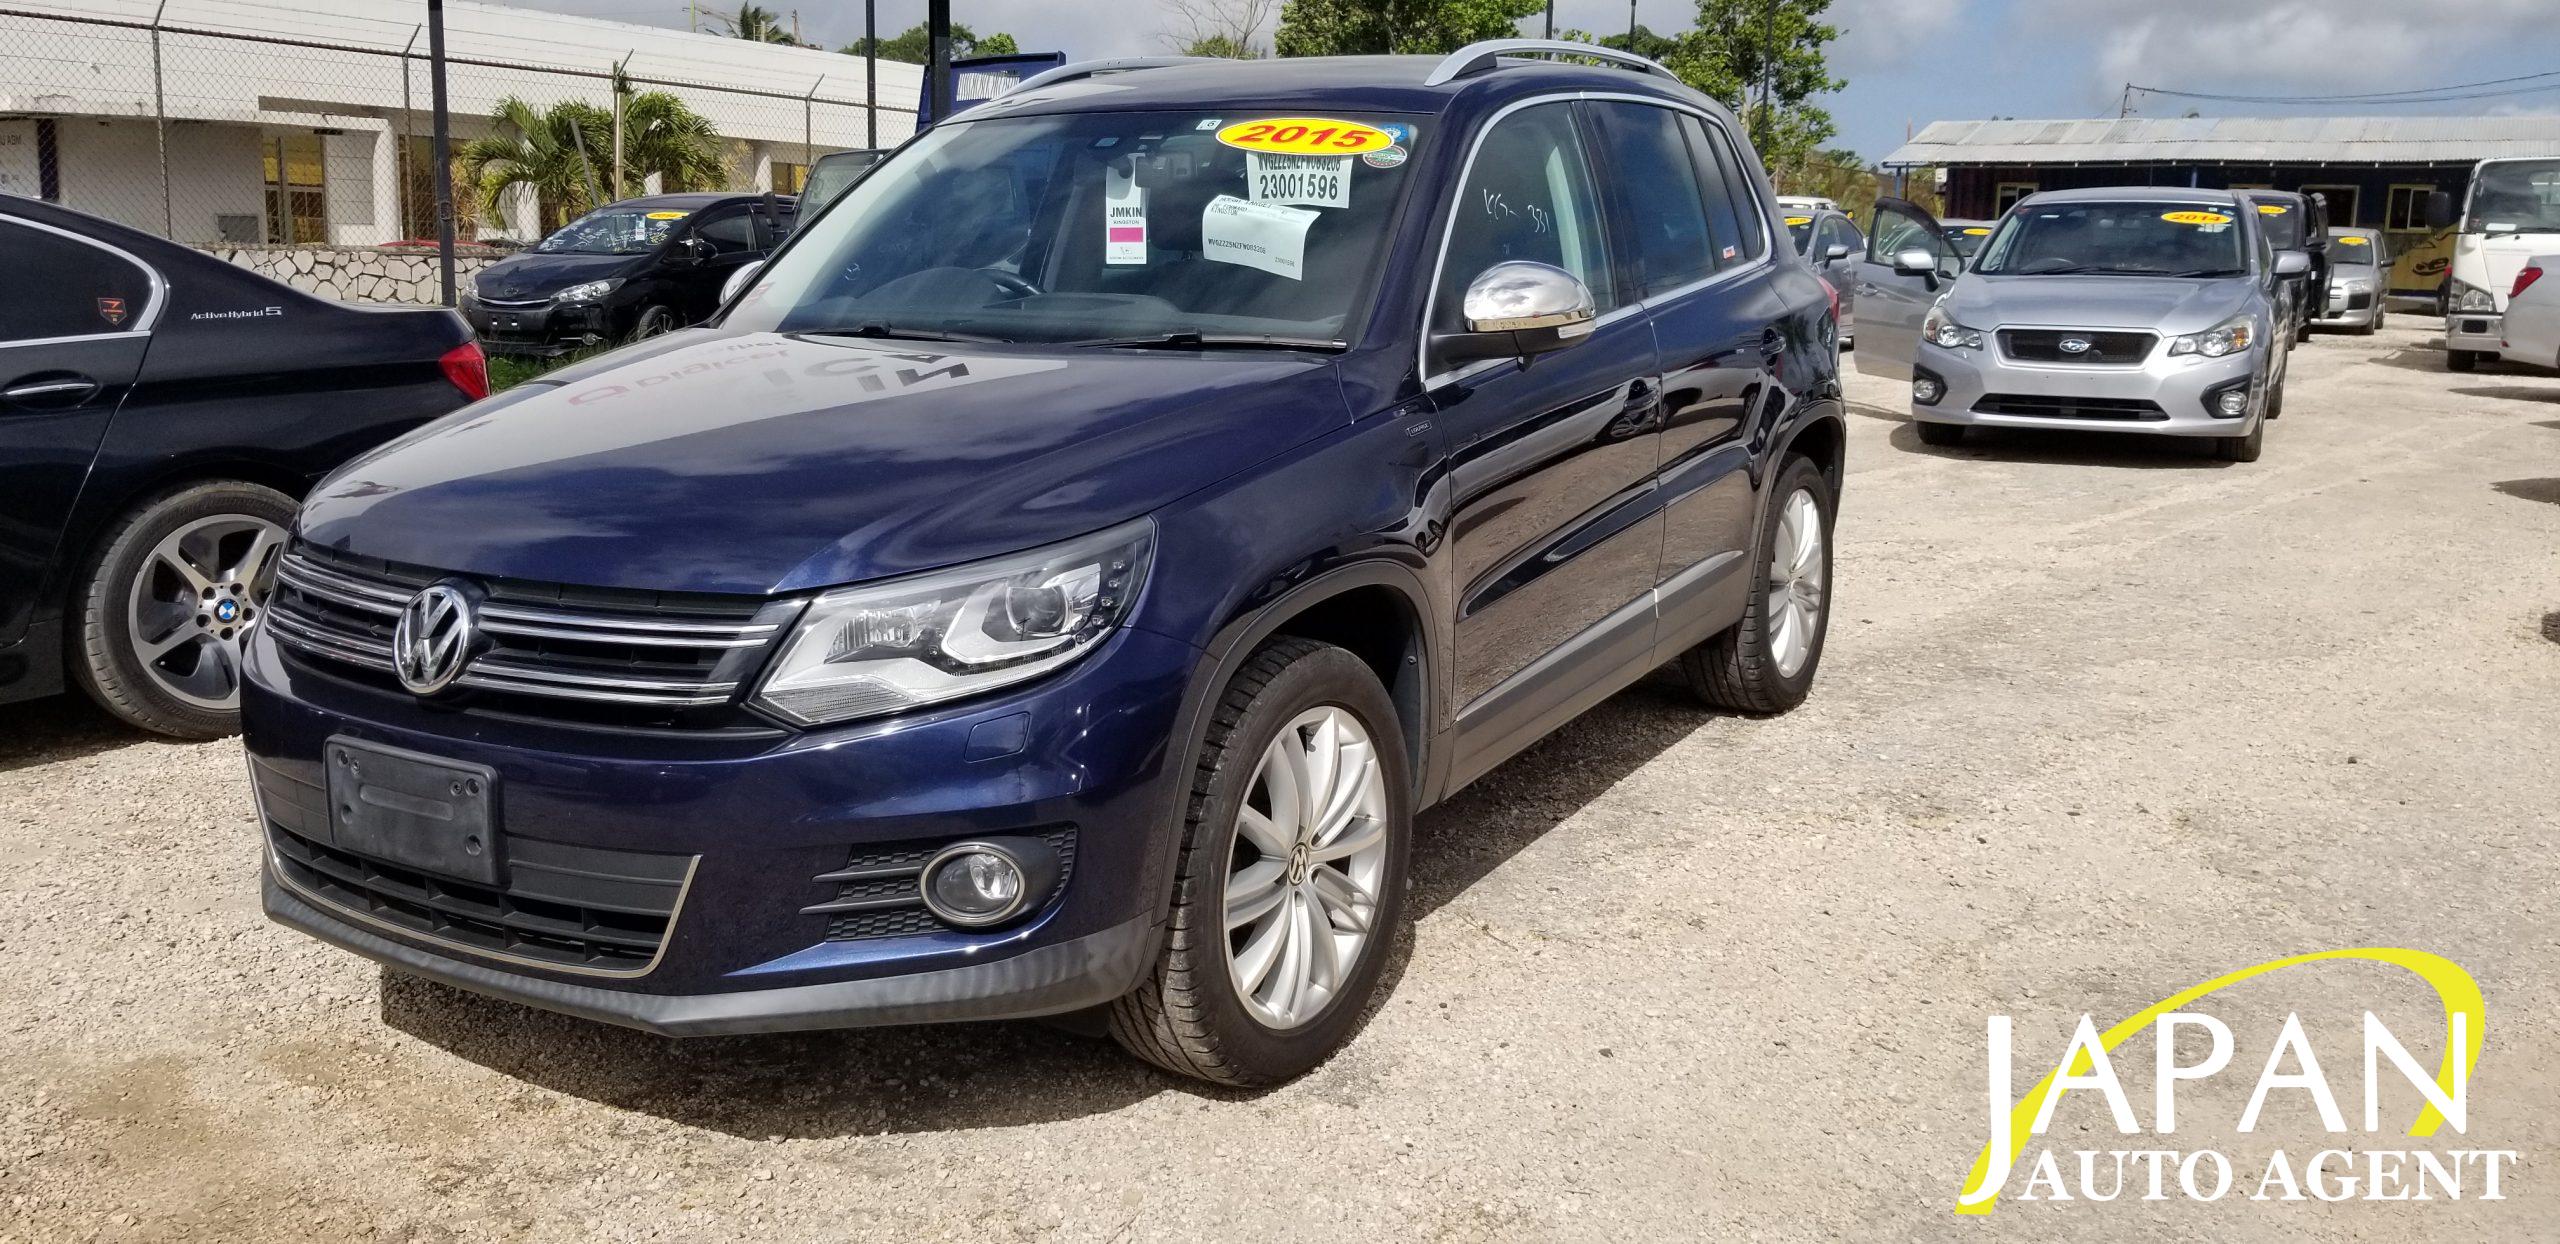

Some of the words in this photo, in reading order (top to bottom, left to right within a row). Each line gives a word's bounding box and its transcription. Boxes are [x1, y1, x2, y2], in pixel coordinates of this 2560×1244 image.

[1233, 125, 1375, 148] 2015
[1259, 173, 1338, 200] 23001596
[1110, 206, 1142, 218] JMKIN
[265, 305, 283, 317] 5
